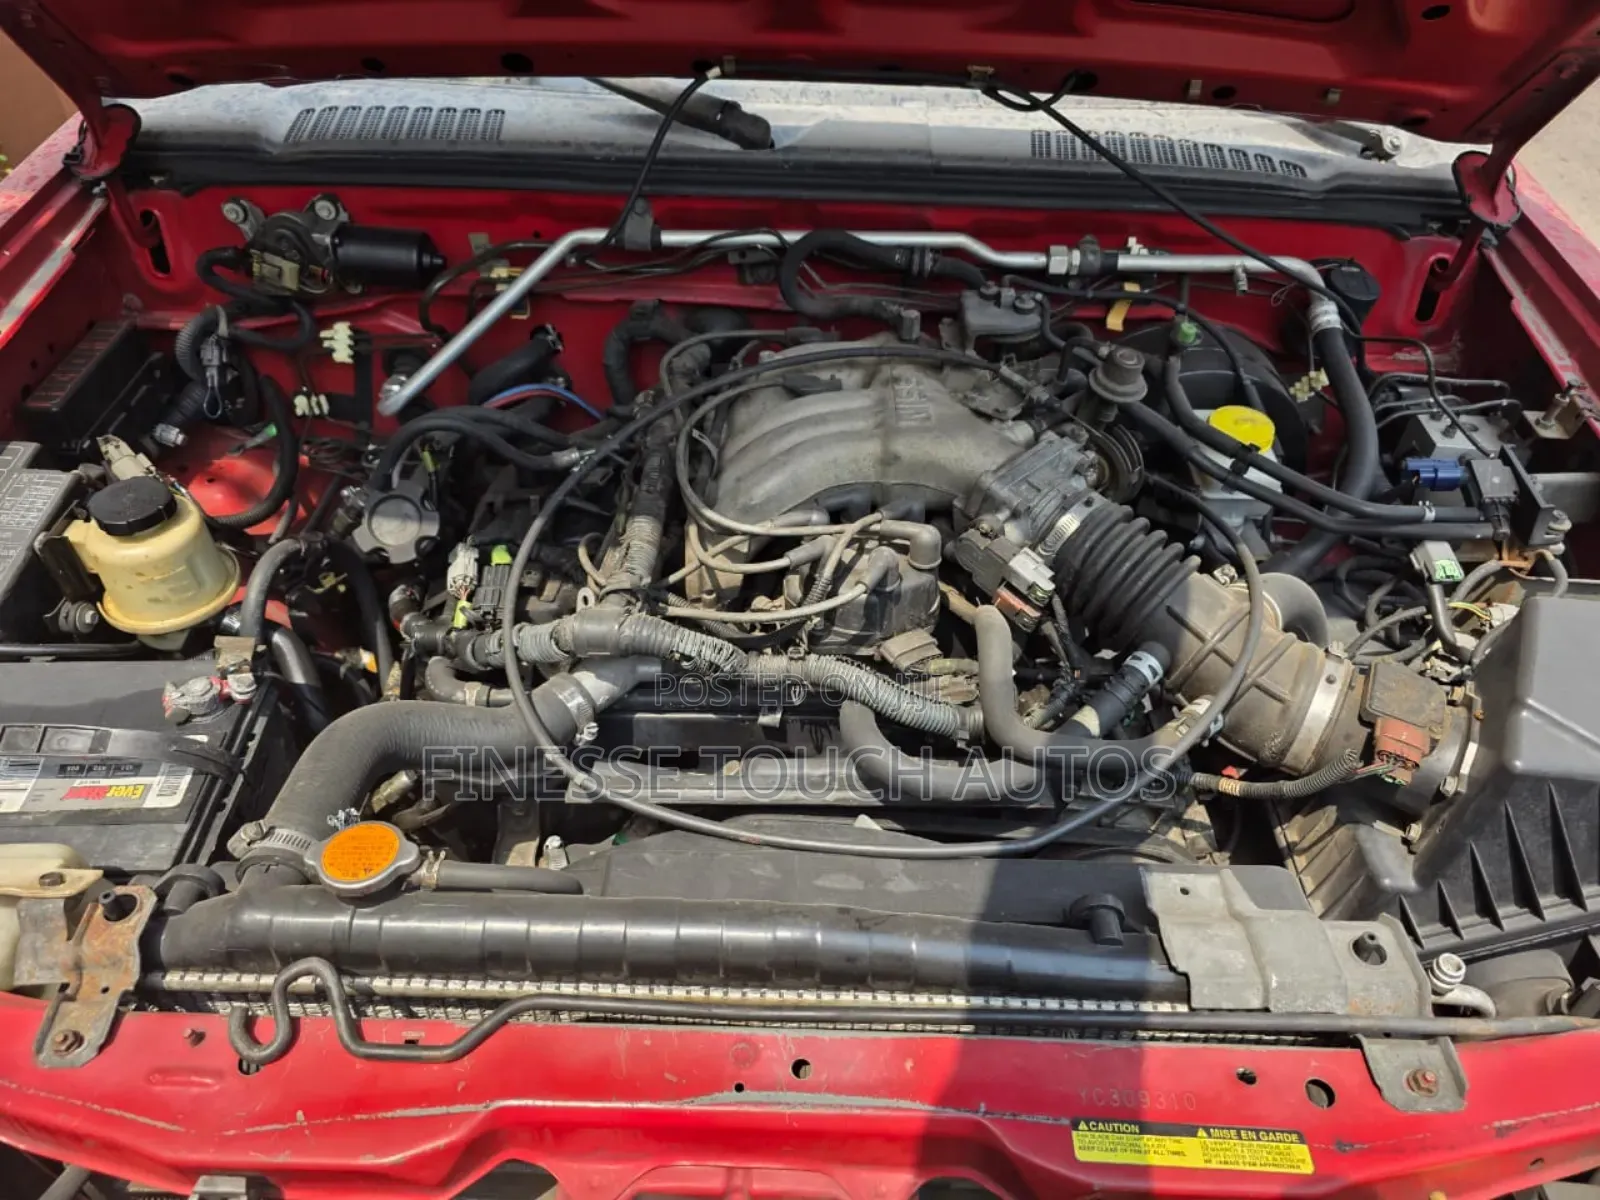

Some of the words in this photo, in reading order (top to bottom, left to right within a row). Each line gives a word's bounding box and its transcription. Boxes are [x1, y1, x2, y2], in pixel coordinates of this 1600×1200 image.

[1089, 1121, 1140, 1134] CAUTION
[1210, 1128, 1240, 1140] MISE
[1242, 1129, 1257, 1141] EN
[1259, 1130, 1300, 1143] GARDE
